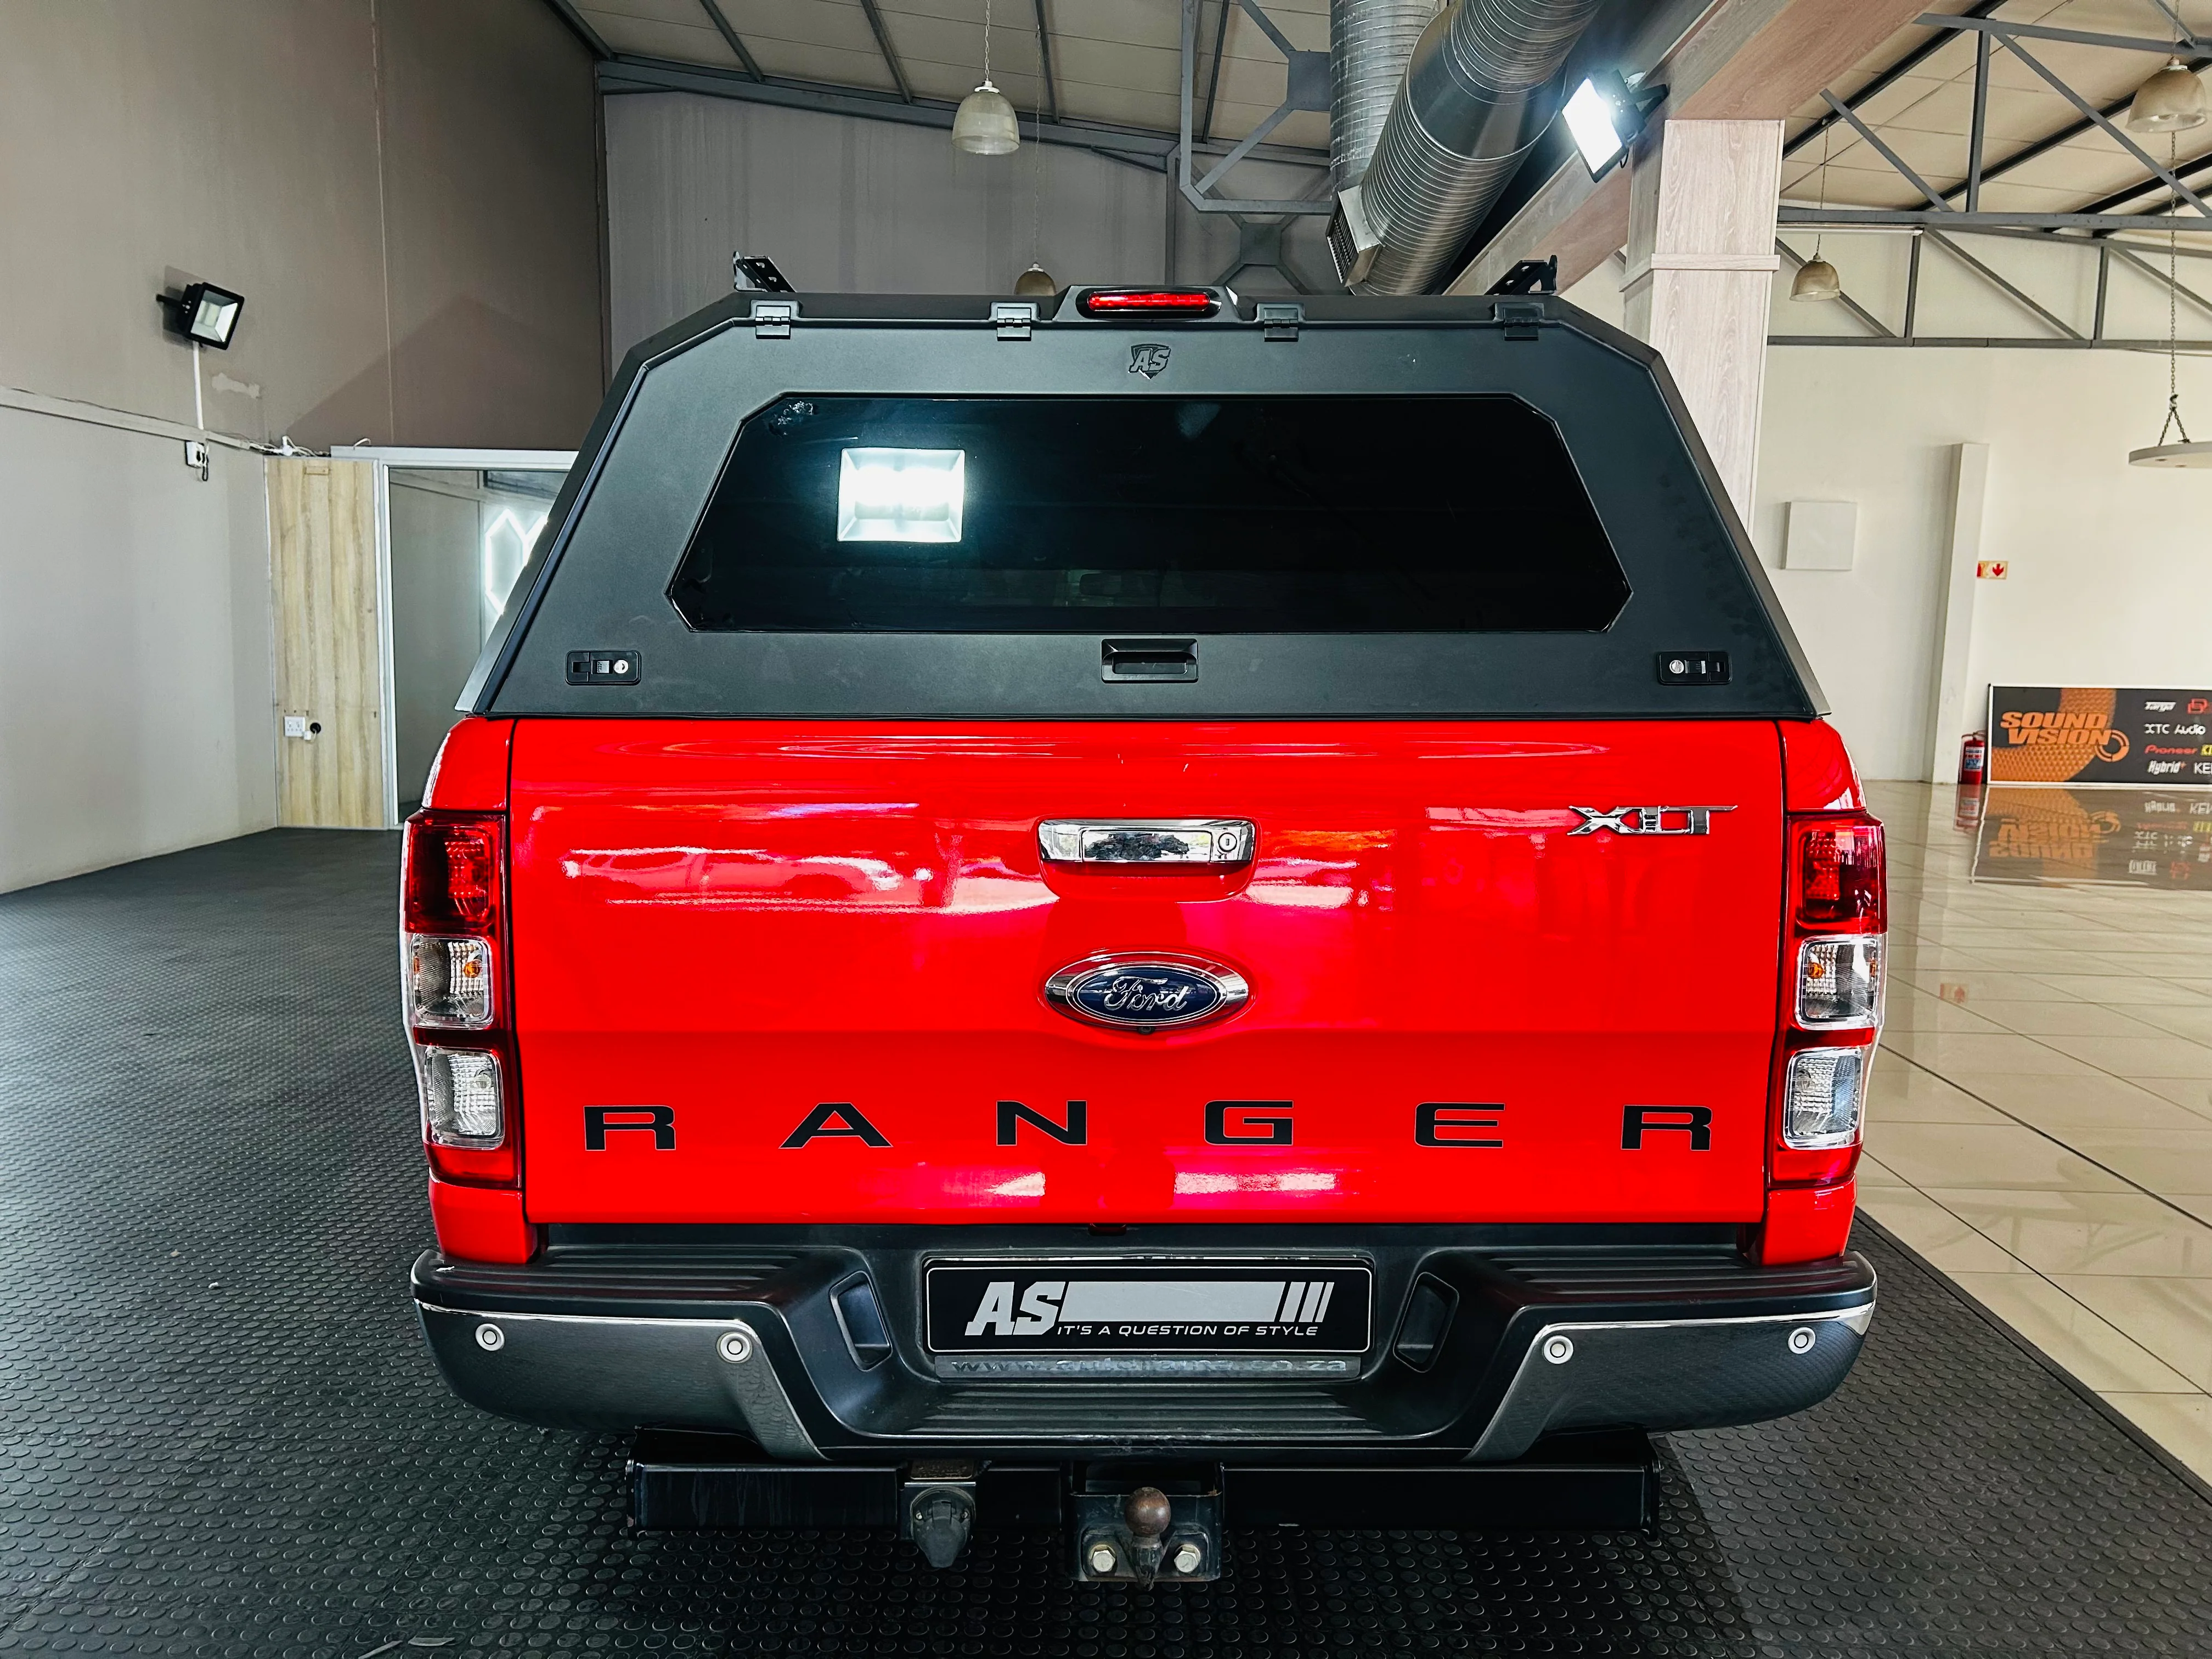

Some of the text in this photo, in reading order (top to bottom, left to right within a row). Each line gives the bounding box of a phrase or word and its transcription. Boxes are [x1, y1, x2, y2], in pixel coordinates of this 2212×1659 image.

[1128, 348, 1171, 373] AS
[2000, 711, 2108, 729] SOUND
[2008, 728, 2112, 745] VISION
[2145, 744, 2198, 755] Pioneer
[2147, 760, 2181, 775] Hybrid
[2194, 762, 2212, 775] KE
[1567, 805, 1738, 836] XLT
[1104, 976, 1189, 1012] Ford
[583, 1099, 1713, 1152] RANGER
[964, 1281, 1066, 1336] AS
[1057, 1325, 1318, 1337] IT'S A QUESTION OF STYLE
